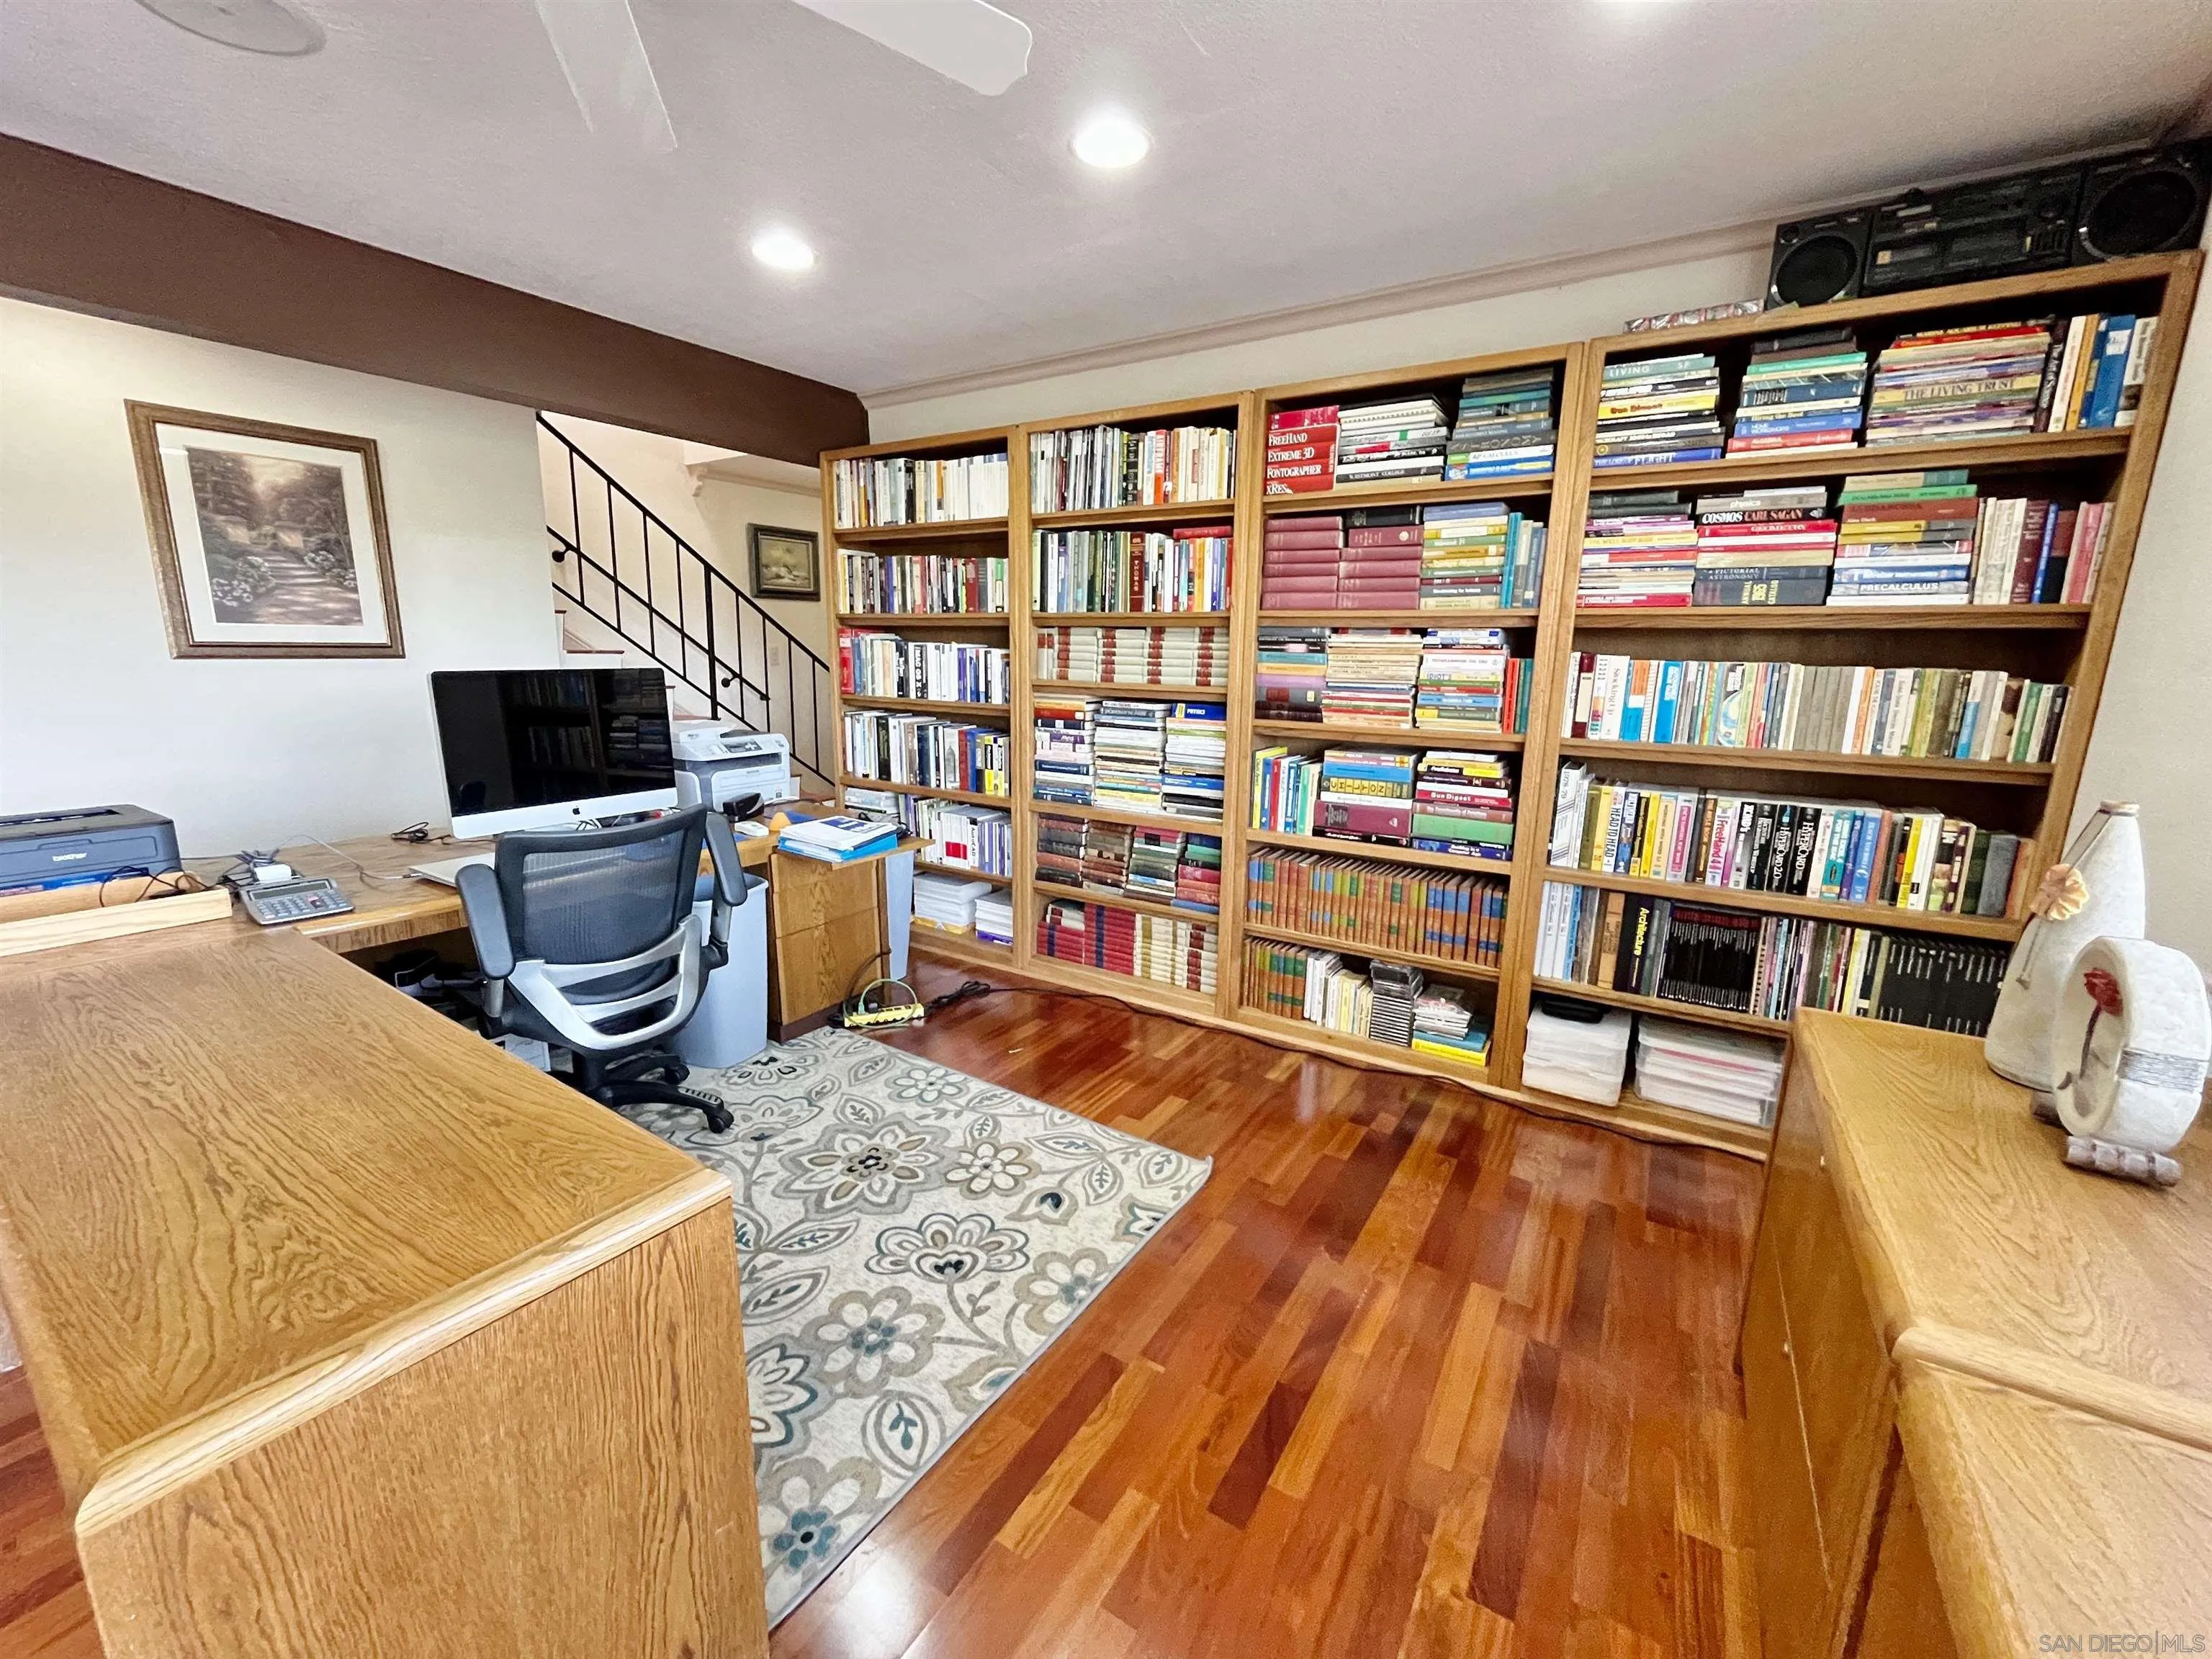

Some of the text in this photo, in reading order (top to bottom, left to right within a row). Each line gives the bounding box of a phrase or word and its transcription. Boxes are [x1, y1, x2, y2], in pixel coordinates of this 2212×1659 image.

[1905, 388, 1927, 400] THE
[1930, 384, 1972, 397] LIVING
[1702, 508, 1803, 524] COSMOS CARL SAGAN
[1860, 582, 1939, 591] PRECALCULUS
[1331, 779, 1384, 793] CHILTON
[1609, 807, 1621, 827] HEAD
[1712, 819, 1728, 858] FreeHand
[1605, 839, 1616, 858] HEAD
[1633, 907, 1650, 956] Architecture
